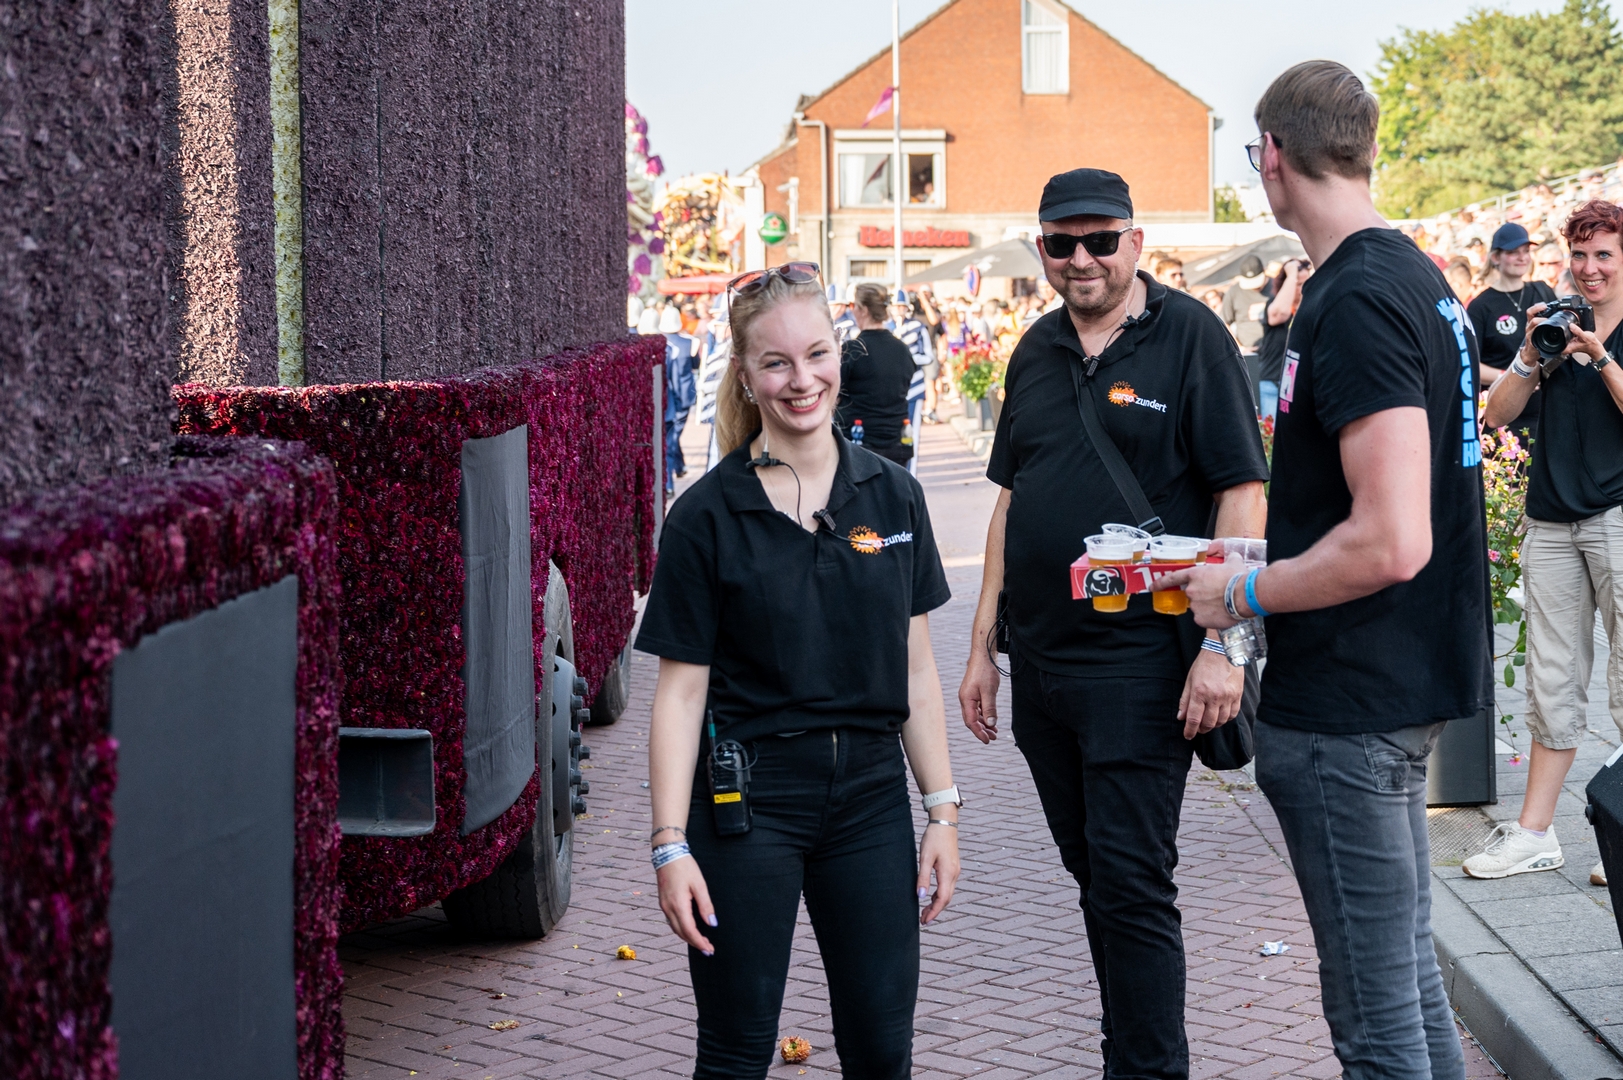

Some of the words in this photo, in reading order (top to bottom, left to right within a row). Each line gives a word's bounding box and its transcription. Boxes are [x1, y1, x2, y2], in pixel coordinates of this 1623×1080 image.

[1111, 392, 1135, 403] corso
[1134, 397, 1167, 413] zundert
[882, 531, 913, 547] zunder
